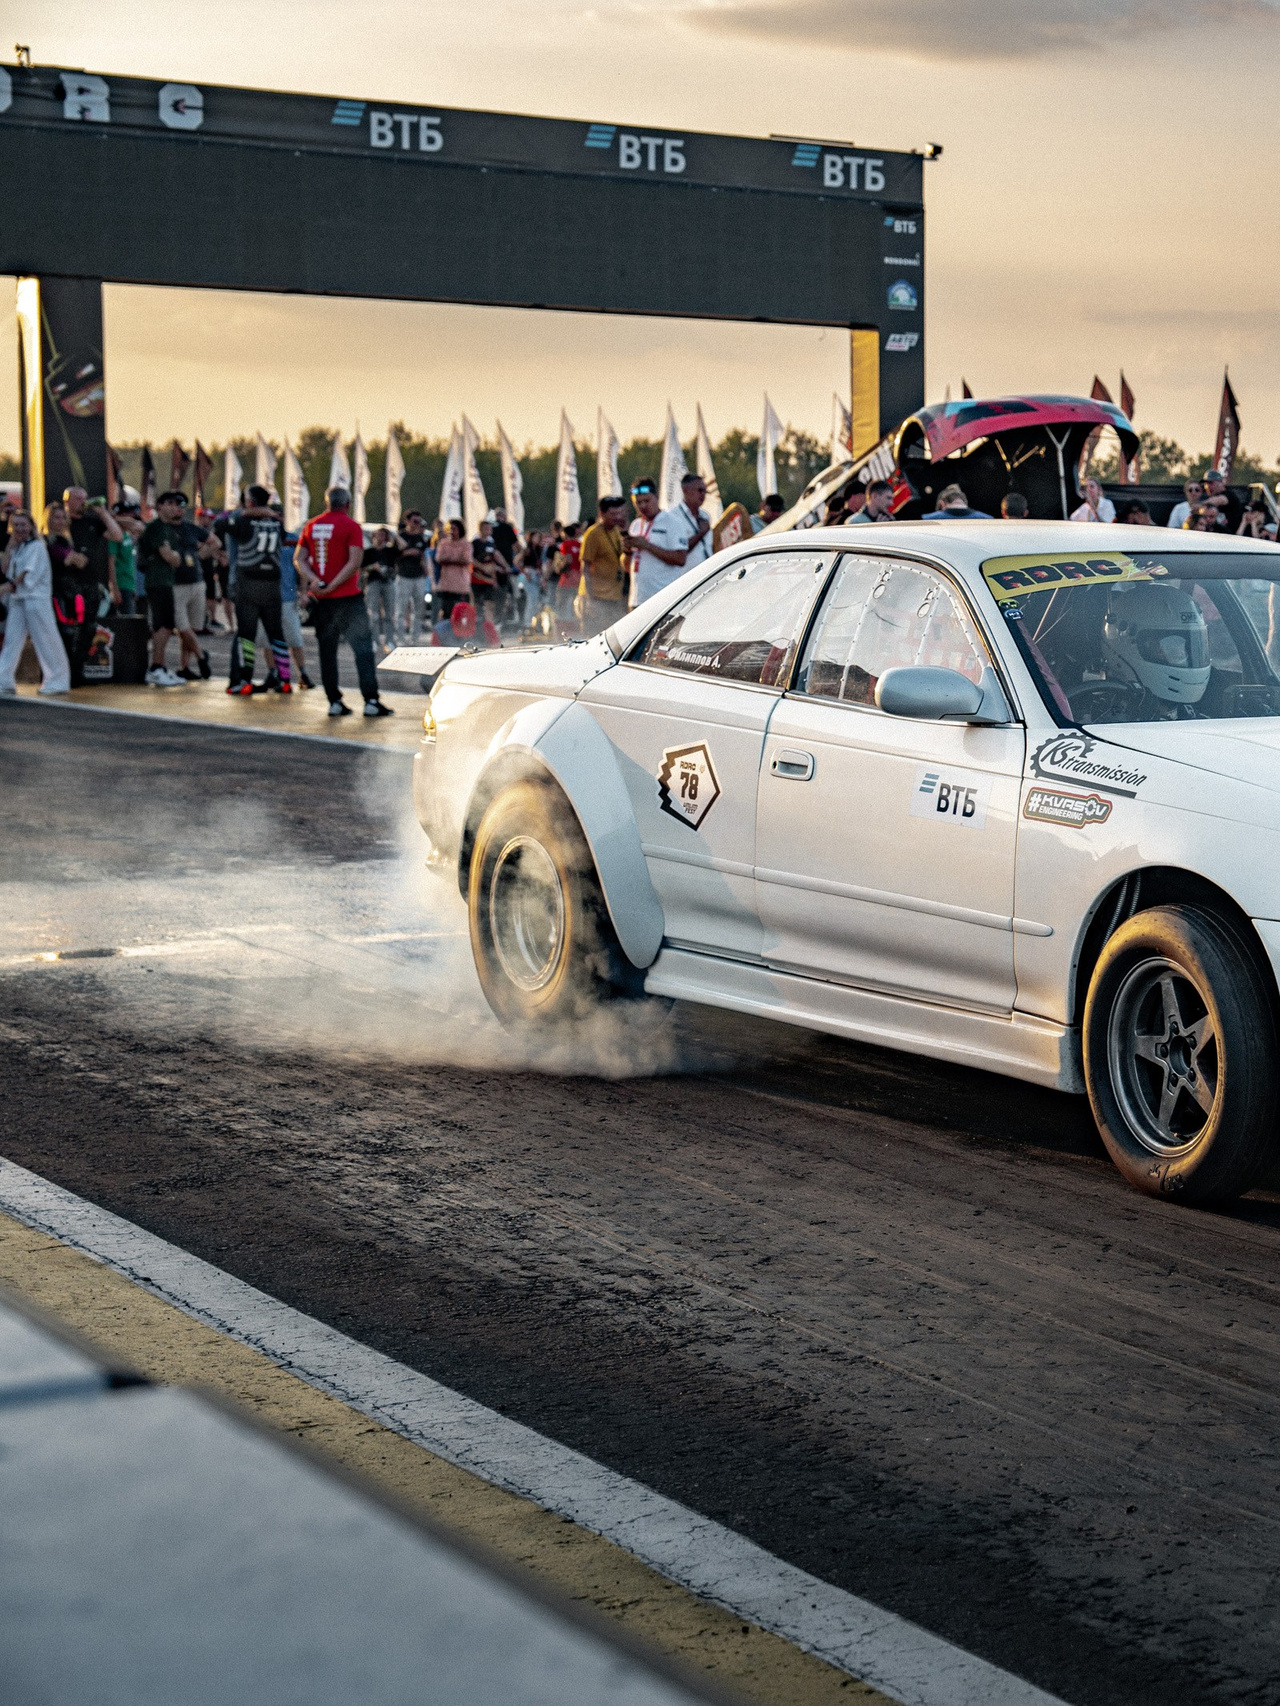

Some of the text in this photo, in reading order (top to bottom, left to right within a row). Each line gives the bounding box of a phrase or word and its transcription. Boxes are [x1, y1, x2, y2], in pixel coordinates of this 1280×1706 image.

[369, 111, 444, 152] ВТБ
[618, 134, 686, 174] ВТБ
[823, 154, 885, 192] ВТБ
[893, 219, 917, 234] ВТБ
[256, 531, 278, 553] 11
[988, 559, 1124, 591] RDRC
[680, 772, 699, 800] 78
[937, 782, 977, 818] ВТБ
[1038, 805, 1084, 821] ENGINEERING
